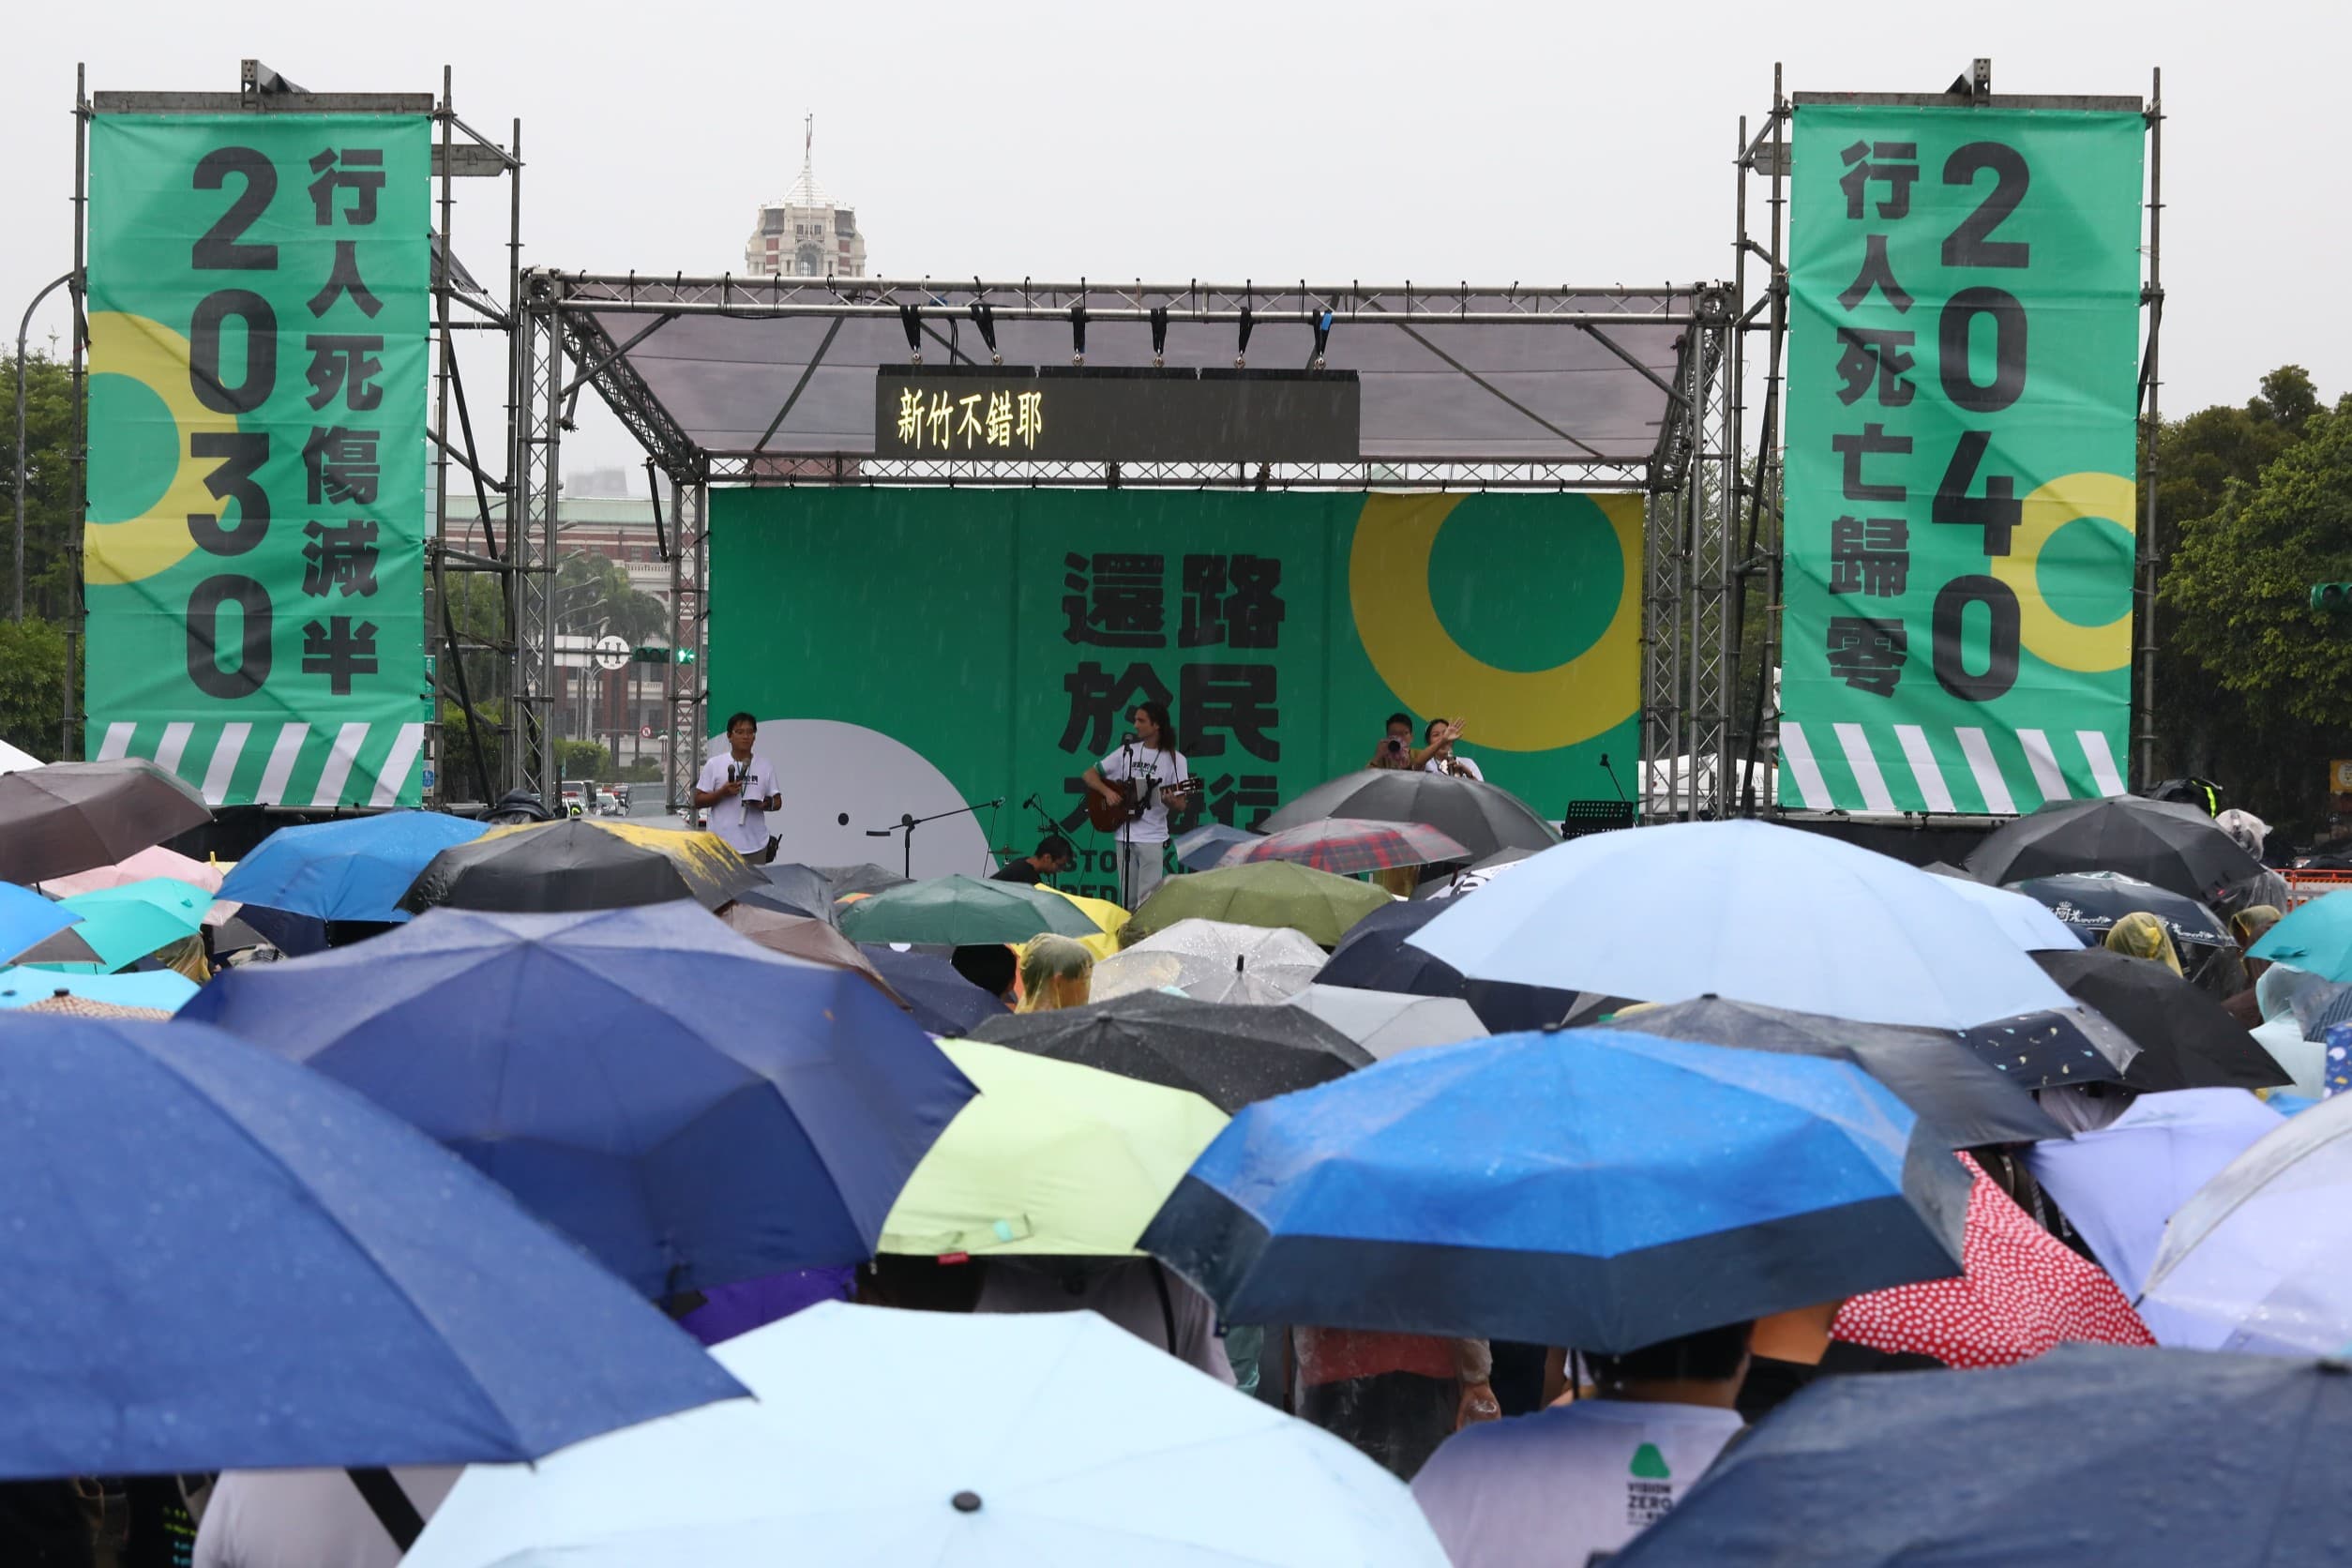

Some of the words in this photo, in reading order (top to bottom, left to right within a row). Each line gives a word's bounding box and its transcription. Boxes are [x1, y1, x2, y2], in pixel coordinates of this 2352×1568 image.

[187, 145, 279, 700] 2030
[301, 146, 385, 697] 行人死傷減半
[897, 387, 1042, 450] 新竹不錯耶
[1062, 551, 1286, 649] 還路
[1825, 140, 1920, 699] 行人死亡歸零
[1931, 141, 2030, 702] 2040
[1058, 661, 1280, 762] 於民
